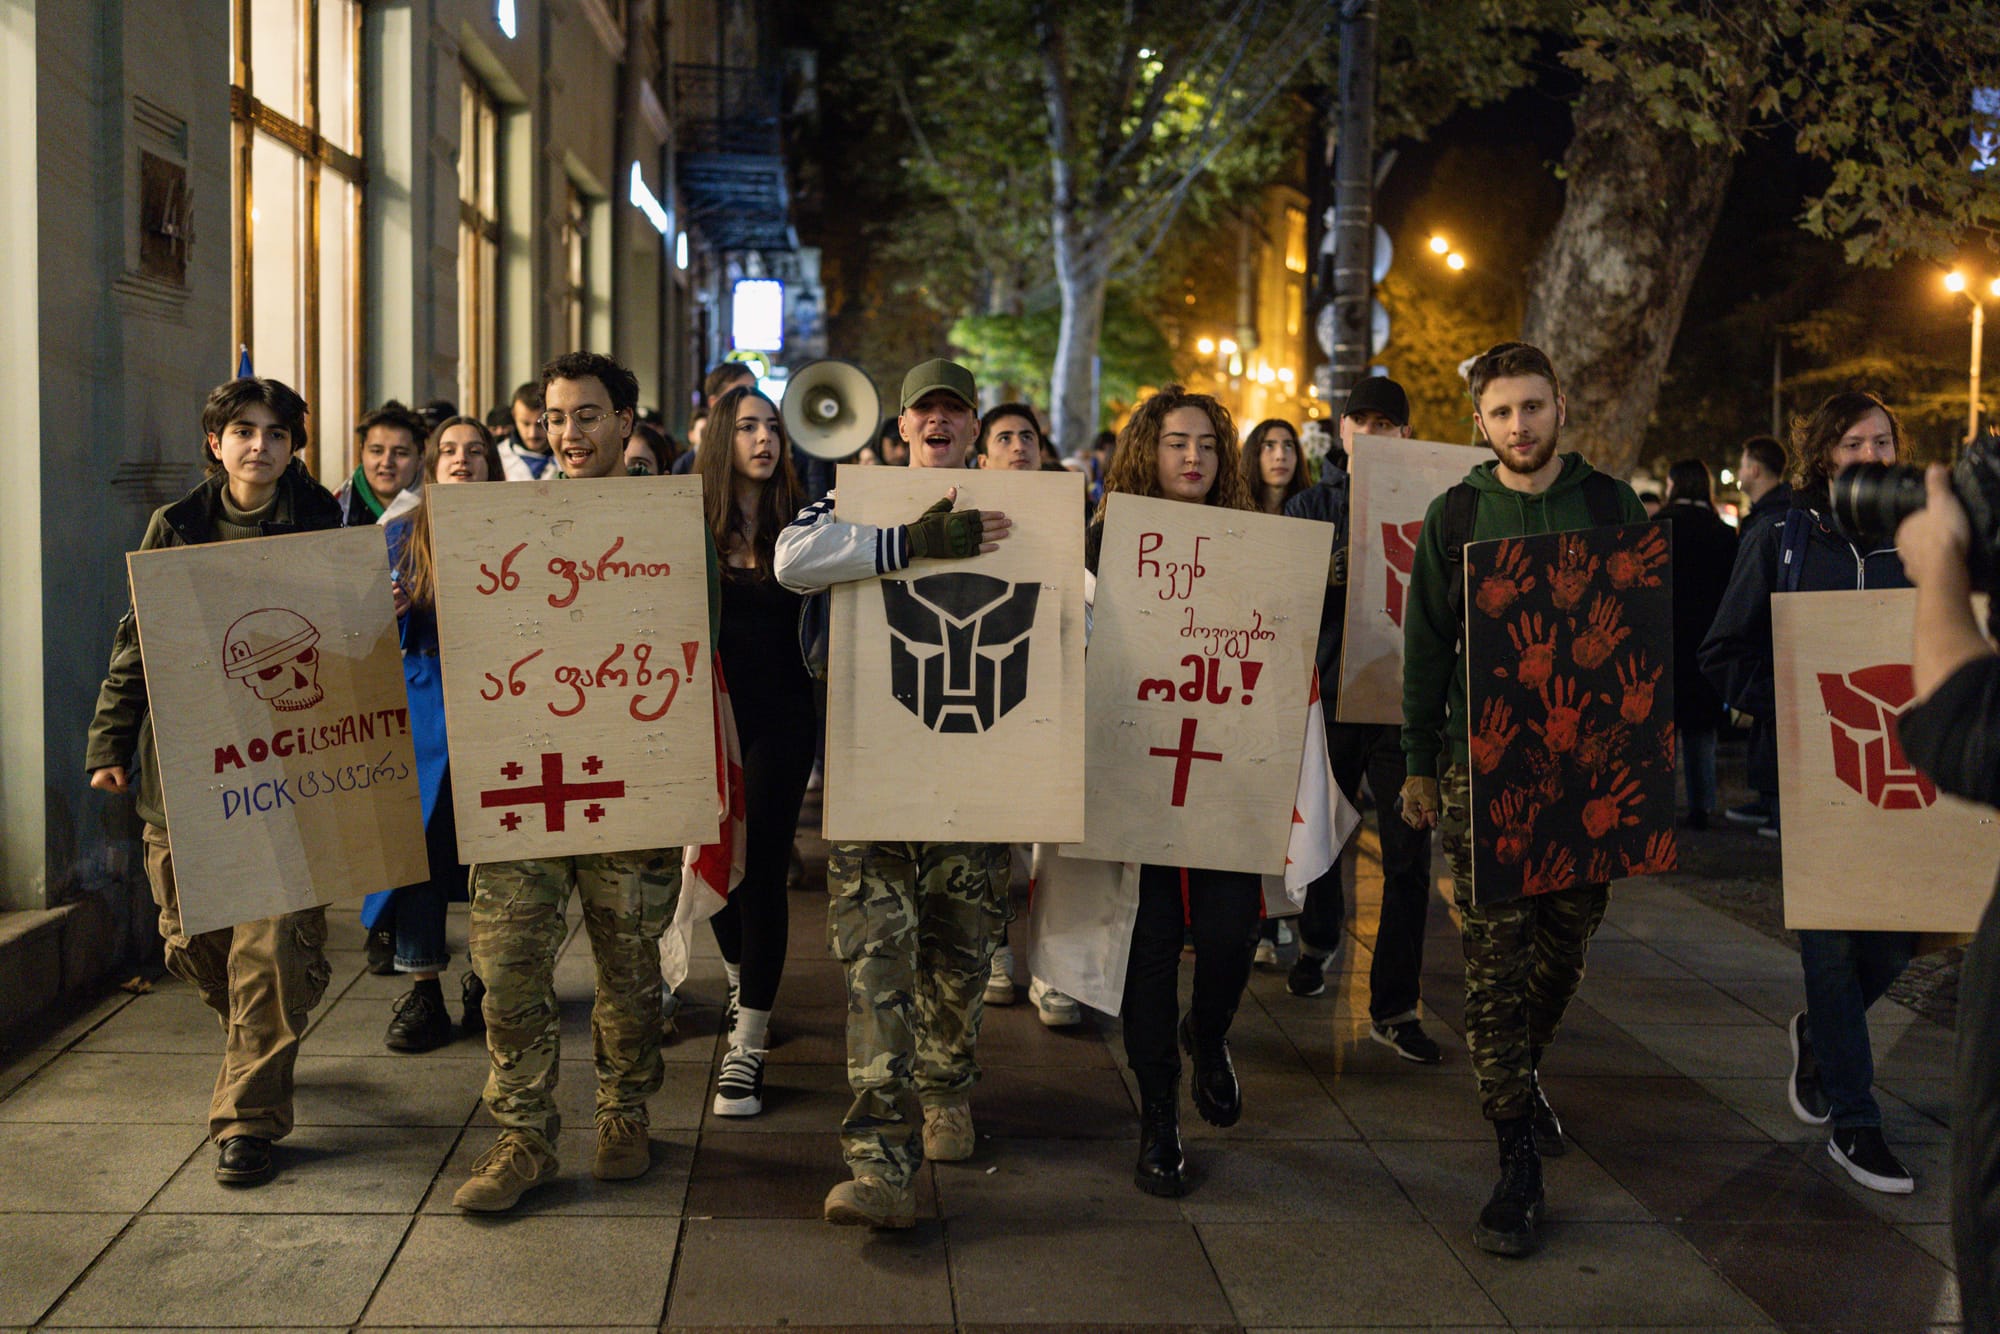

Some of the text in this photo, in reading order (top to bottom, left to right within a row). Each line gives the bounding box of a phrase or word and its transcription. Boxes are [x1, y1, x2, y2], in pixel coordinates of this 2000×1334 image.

[476, 536, 671, 608] ან ფარით
[1138, 532, 1210, 600] ჩვენ
[1180, 606, 1276, 659] მოვიგებთ
[480, 640, 699, 722] ან ფარზე!
[1137, 654, 1264, 705] ომს!
